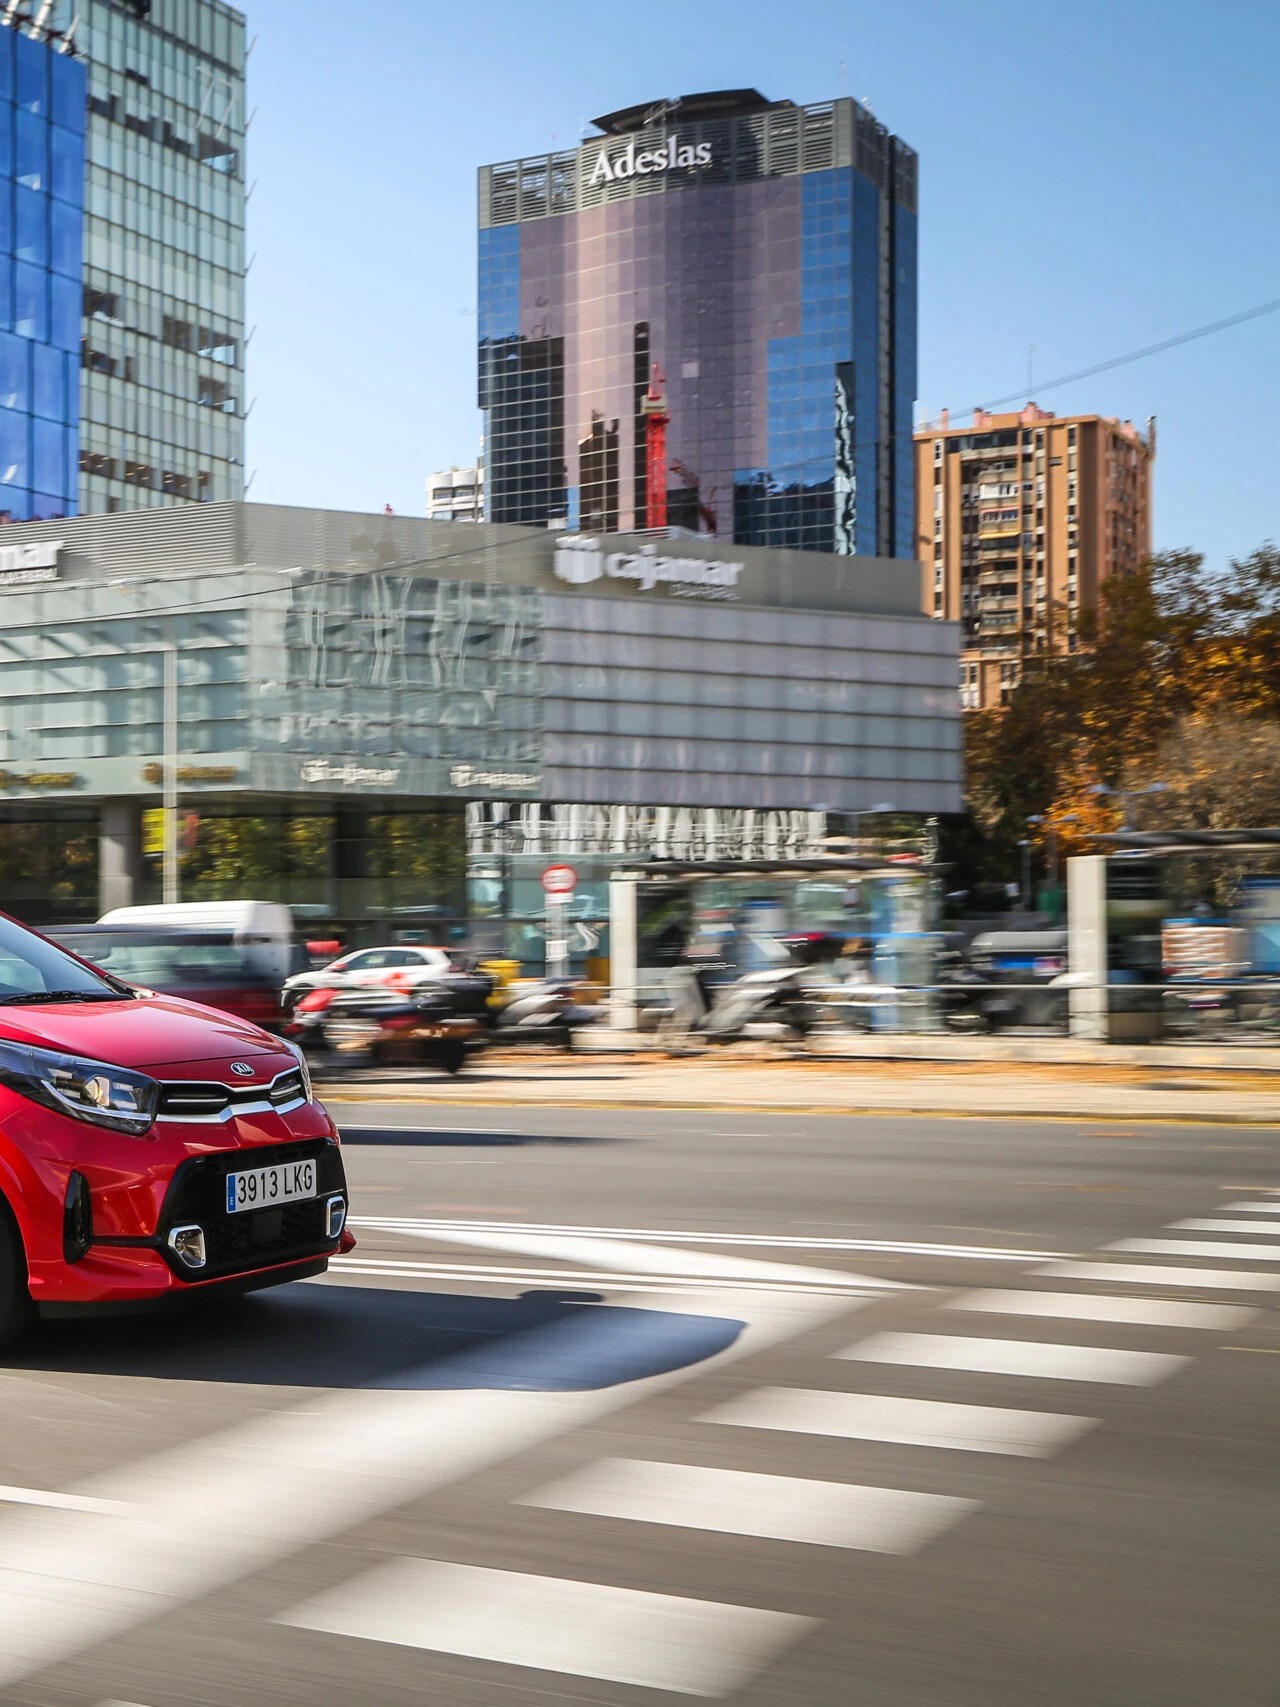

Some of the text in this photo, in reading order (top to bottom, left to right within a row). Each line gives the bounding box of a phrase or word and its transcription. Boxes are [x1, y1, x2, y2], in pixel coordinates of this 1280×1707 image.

[589, 134, 712, 185] Adeslas
[606, 544, 744, 590] cajamar
[237, 1163, 313, 1204] 3913 LKG
